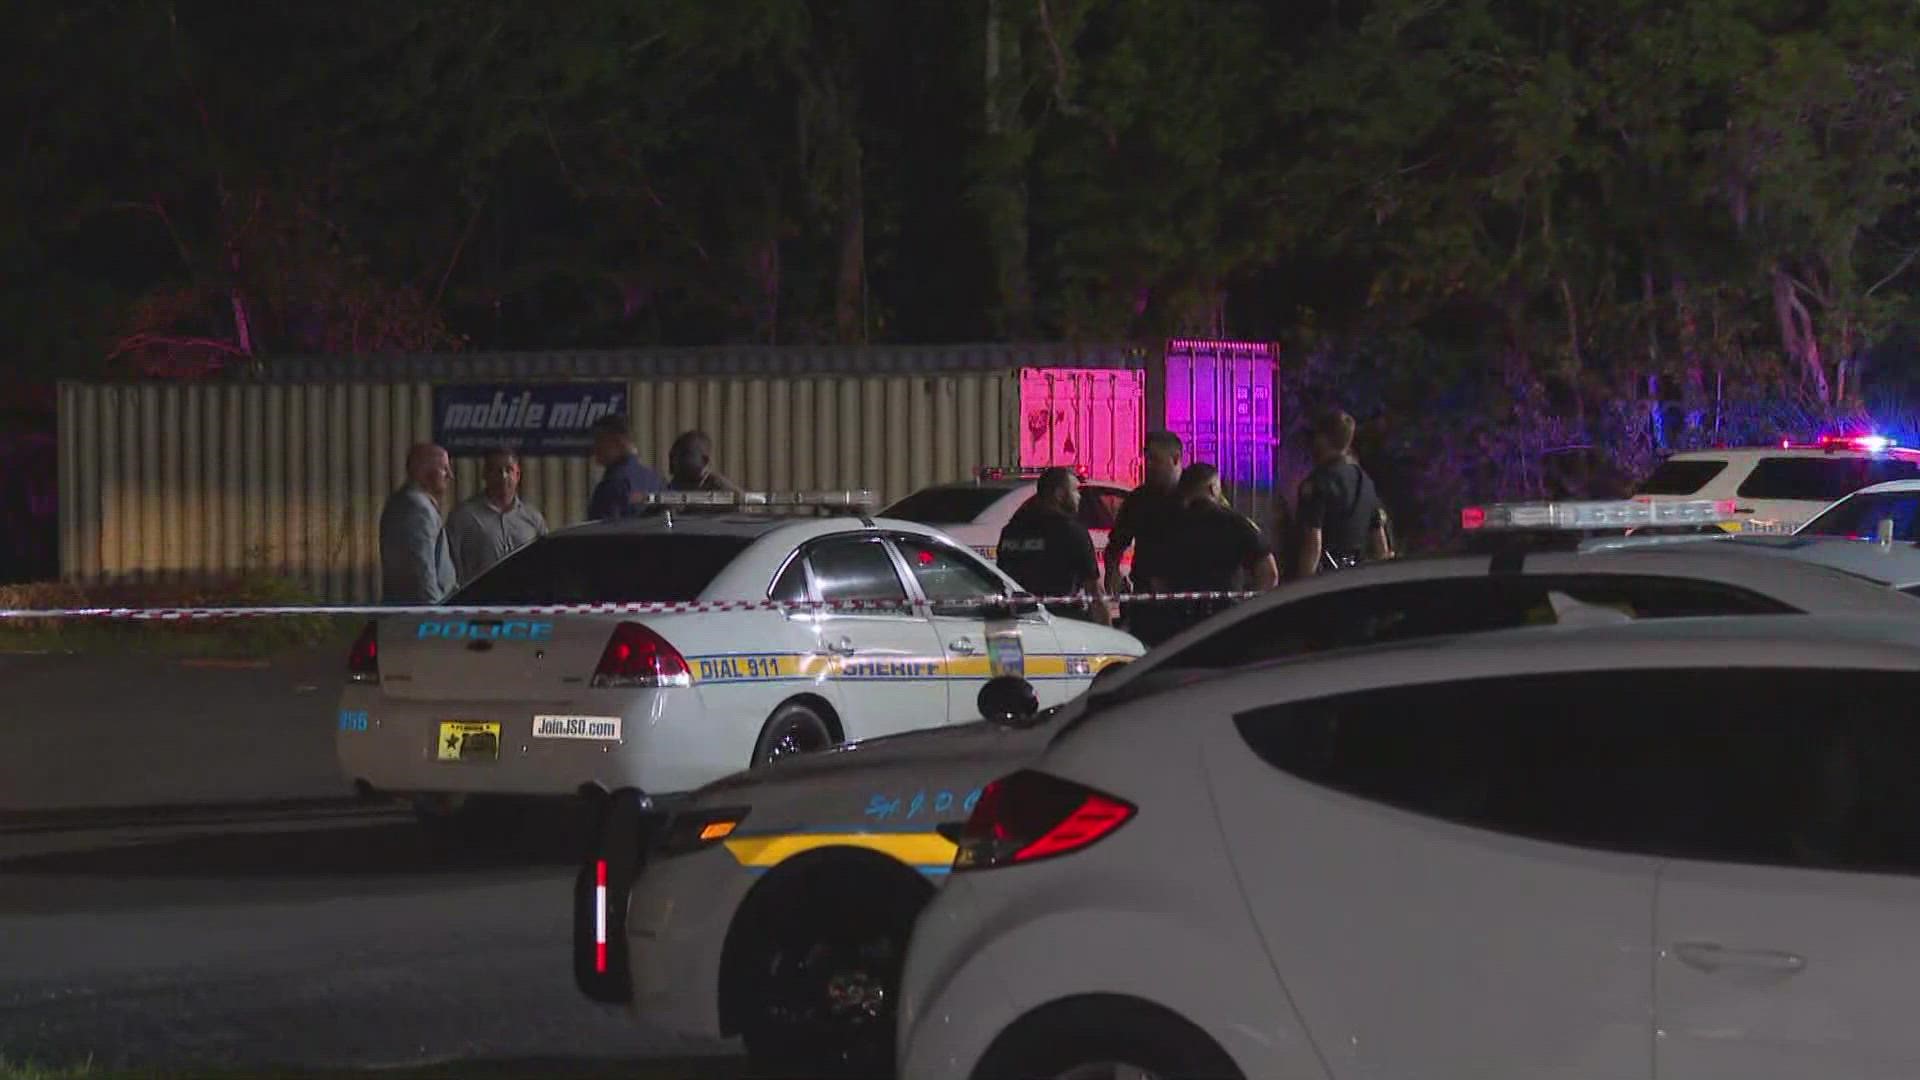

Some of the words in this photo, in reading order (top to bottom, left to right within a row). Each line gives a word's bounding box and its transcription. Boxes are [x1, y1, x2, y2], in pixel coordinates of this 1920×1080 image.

[443, 391, 545, 430] mobile
[416, 620, 554, 641] POLICE
[699, 659, 743, 681] DIAL
[747, 658, 781, 677] 911
[842, 660, 940, 677] SHERIFF
[537, 716, 616, 737] JoinJSO.com
